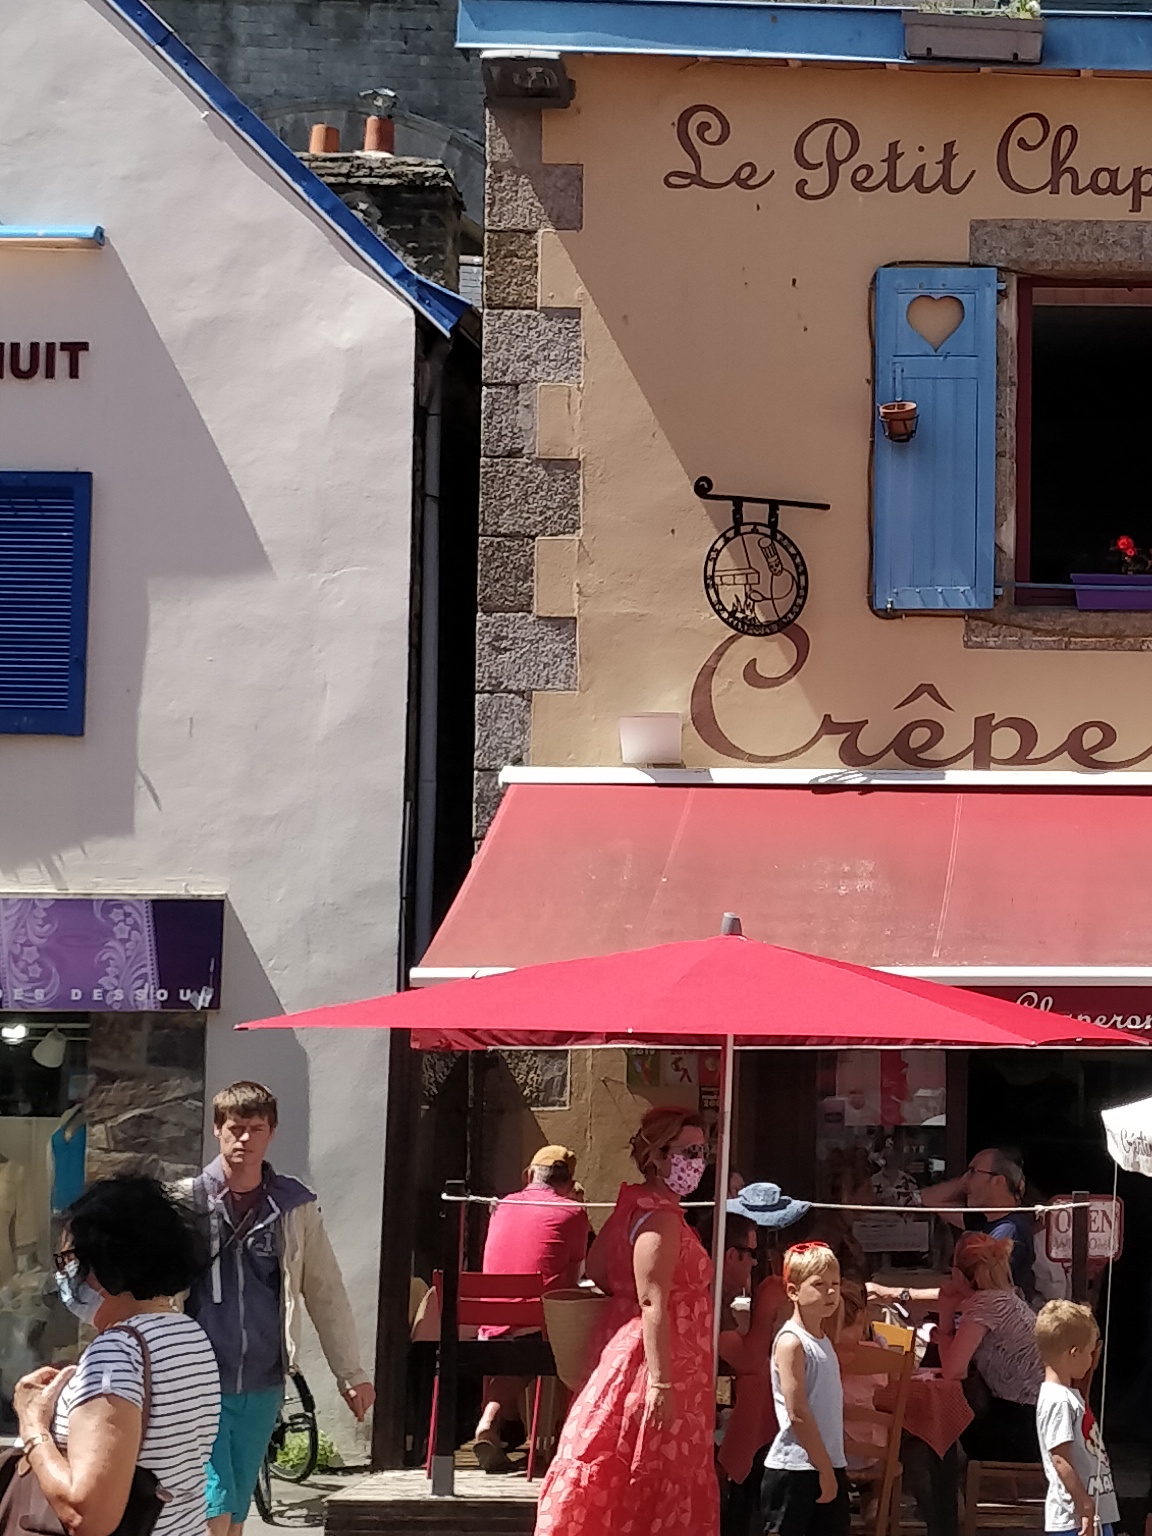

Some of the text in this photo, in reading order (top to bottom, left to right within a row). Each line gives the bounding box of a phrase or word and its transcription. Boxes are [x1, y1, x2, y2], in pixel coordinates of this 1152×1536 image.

[663, 103, 774, 191] Le
[794, 116, 976, 201] Petit
[0, 340, 90, 380] UIT
[0, 987, 213, 1002] ES DESSOU
[1055, 1209, 1118, 1234] OEN
